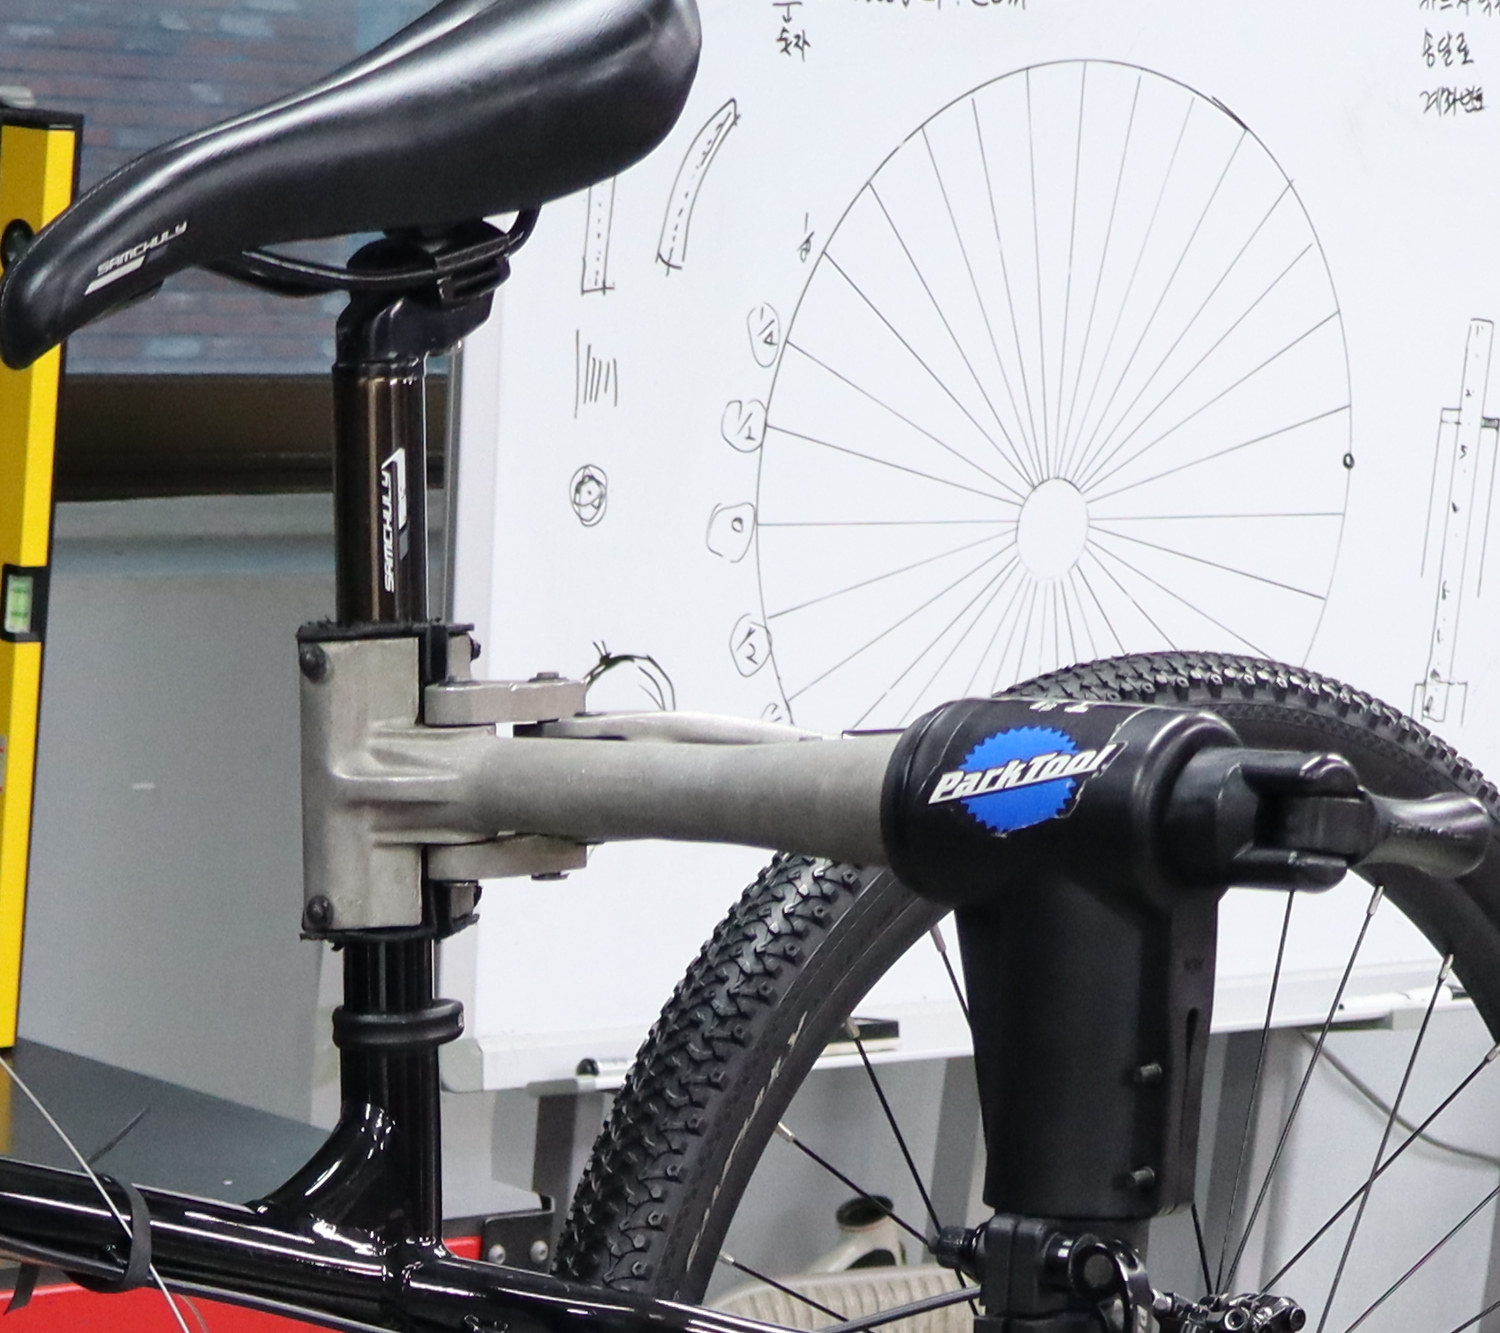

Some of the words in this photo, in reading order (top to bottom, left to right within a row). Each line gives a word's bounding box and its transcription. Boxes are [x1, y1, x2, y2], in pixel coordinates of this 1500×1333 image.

[96, 220, 188, 277] SAMCHULY
[381, 470, 395, 593] SAMCHULY
[928, 742, 1118, 804] ParkTool
